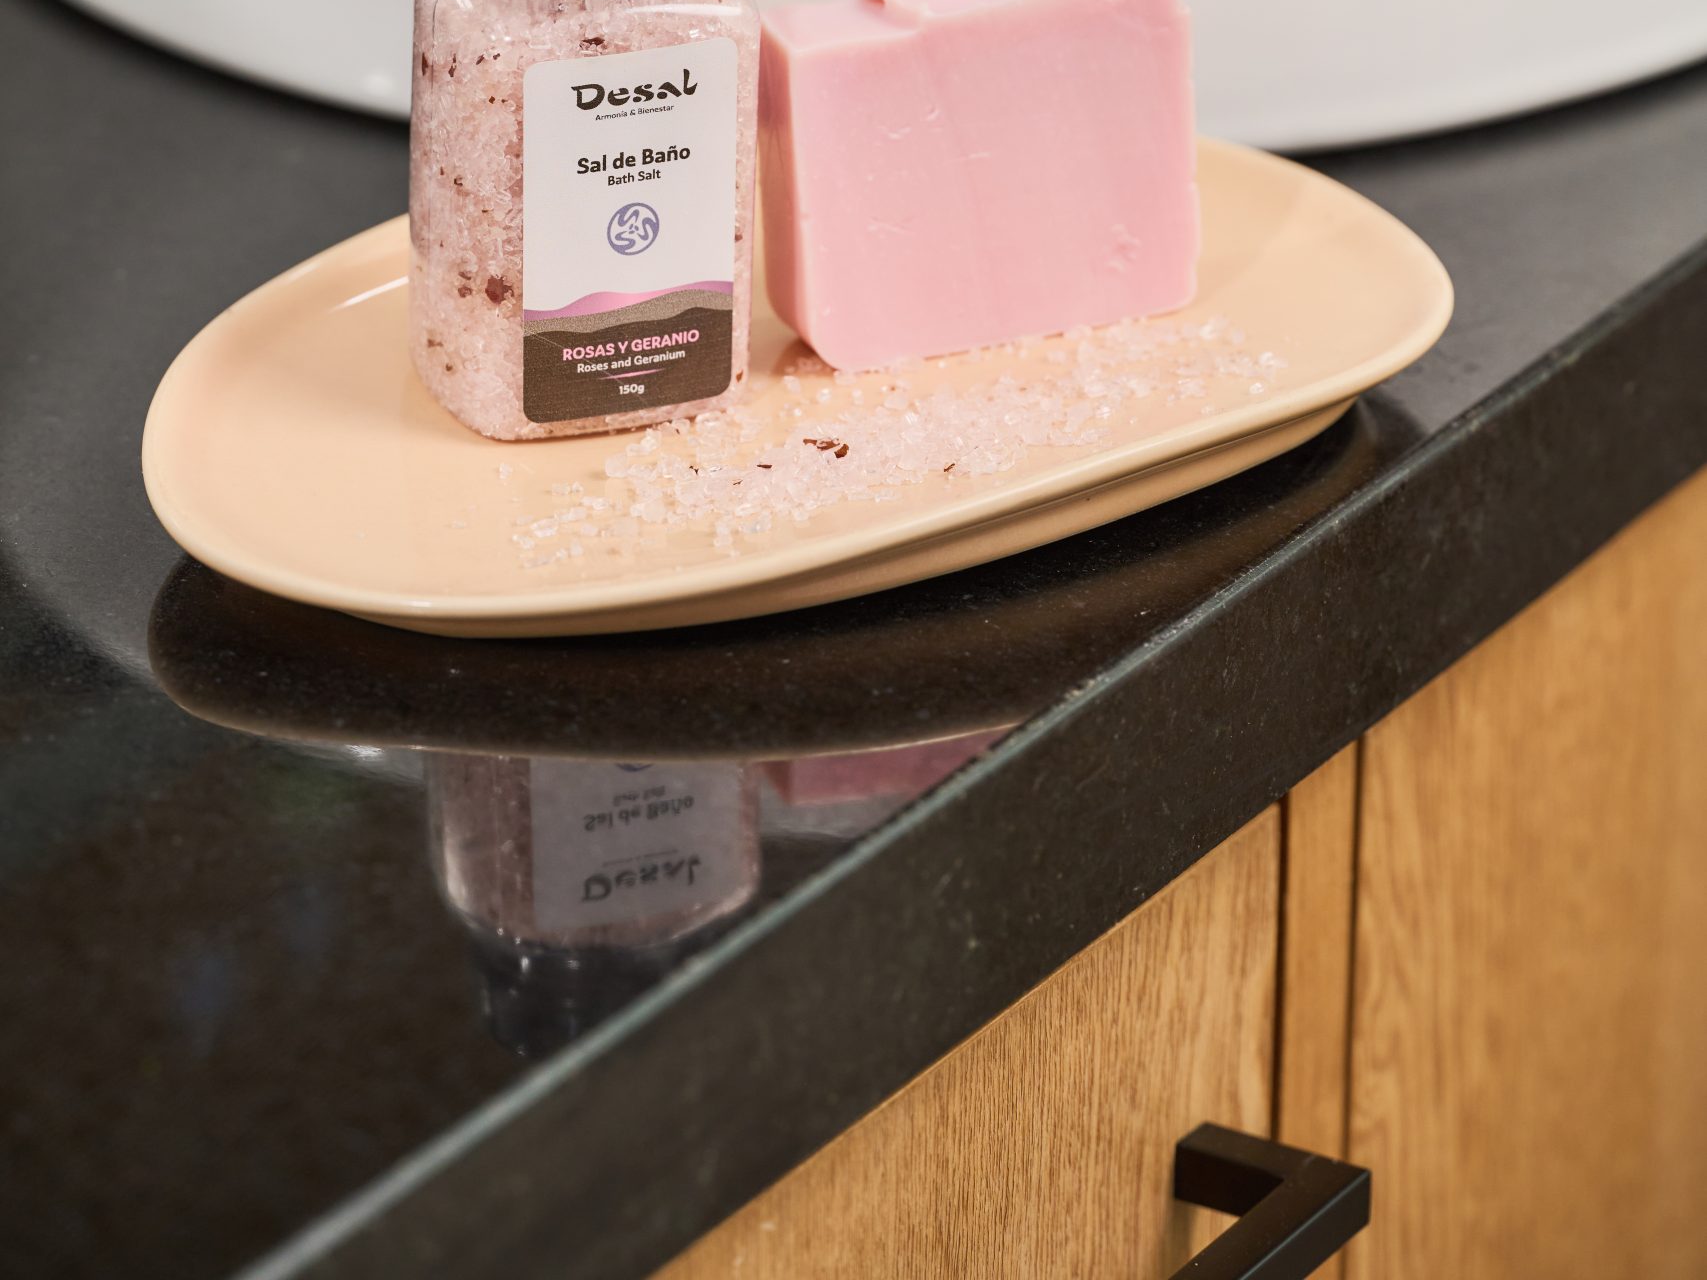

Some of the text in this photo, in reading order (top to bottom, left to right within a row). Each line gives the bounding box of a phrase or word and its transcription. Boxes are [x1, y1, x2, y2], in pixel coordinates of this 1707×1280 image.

[571, 68, 698, 111] Desal
[629, 108, 636, 117] &
[637, 104, 675, 116] Bienestar
[577, 145, 691, 175] Sal de Baño
[607, 168, 662, 186] Bath Salt
[562, 329, 700, 362] ROSAS Y GERANIO
[577, 349, 686, 374] Roses and Geranium
[618, 383, 645, 395] 150g
